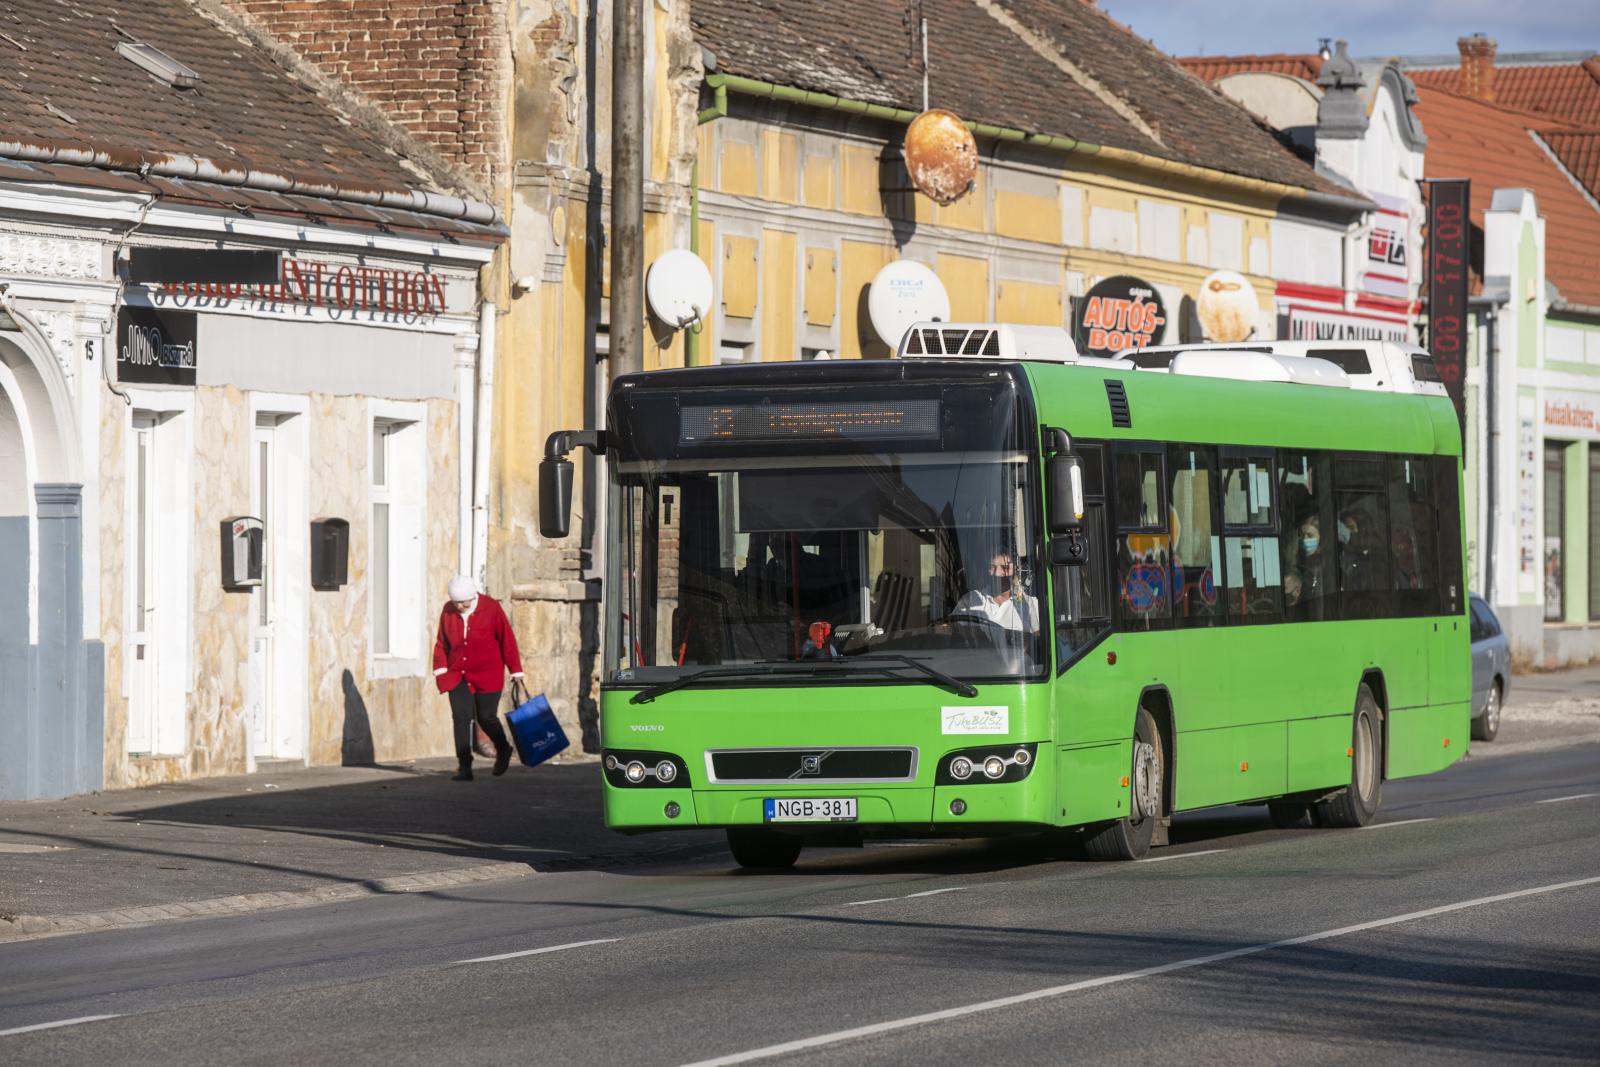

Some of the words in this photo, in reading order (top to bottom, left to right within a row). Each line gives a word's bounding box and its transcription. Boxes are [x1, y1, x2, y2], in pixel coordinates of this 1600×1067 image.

[336, 265, 446, 316] OTTHON
[85, 339, 94, 361] 15
[628, 724, 665, 733] VOLVO
[778, 800, 852, 817] NGB-381
